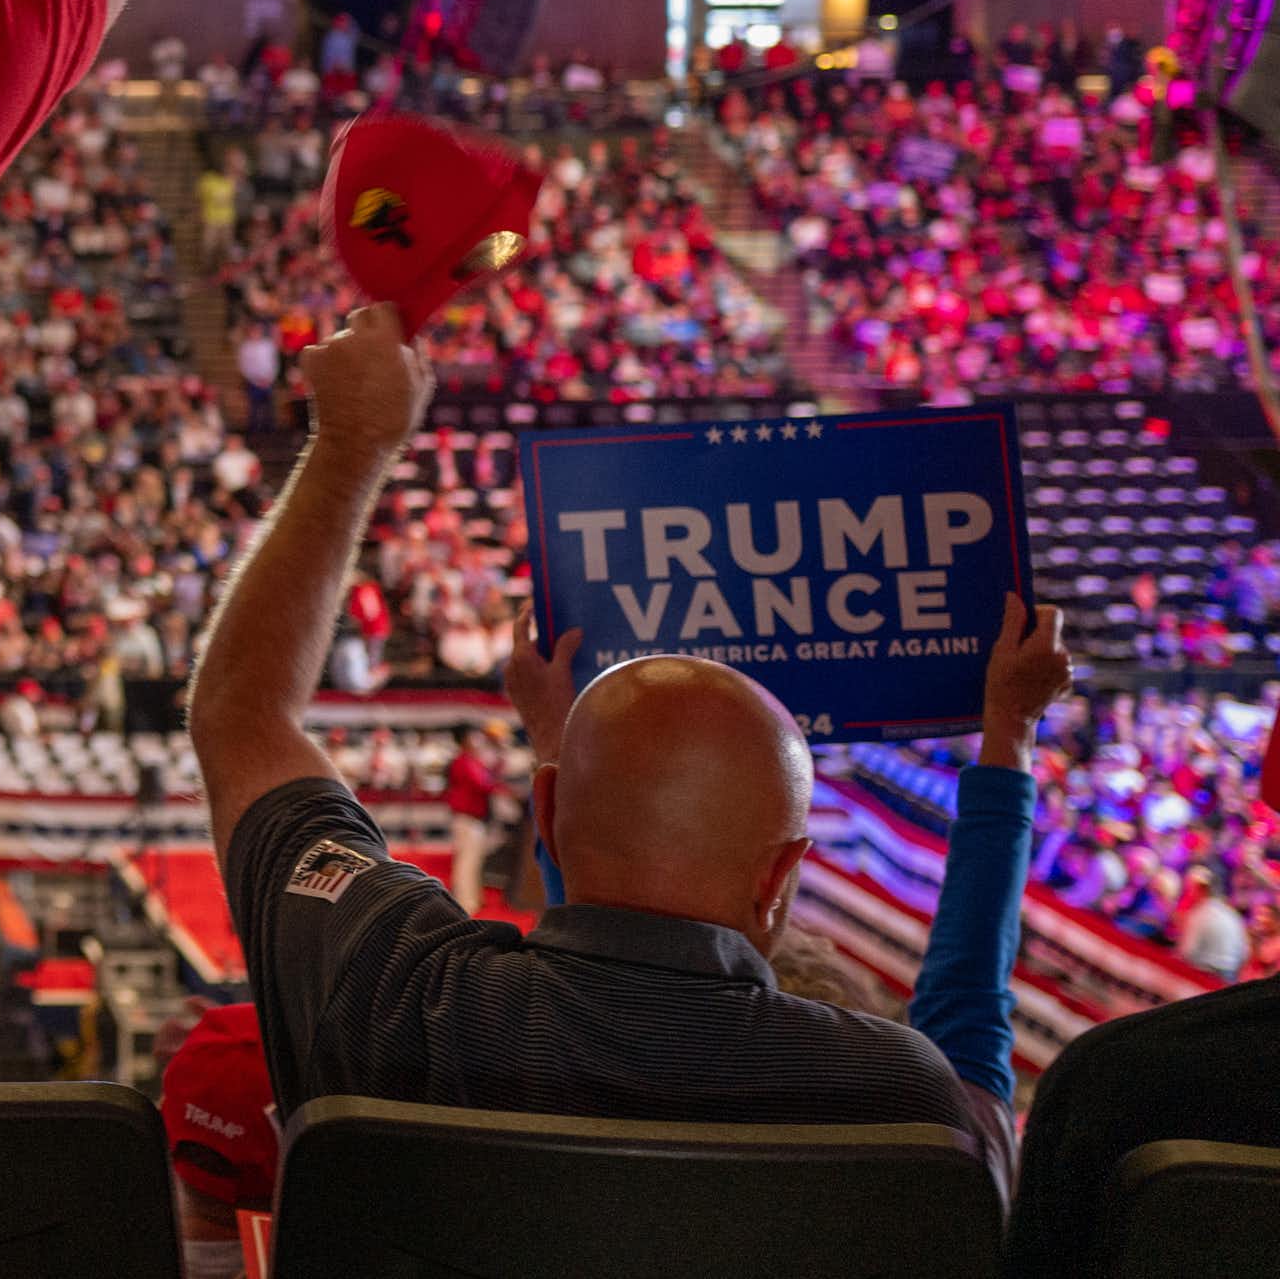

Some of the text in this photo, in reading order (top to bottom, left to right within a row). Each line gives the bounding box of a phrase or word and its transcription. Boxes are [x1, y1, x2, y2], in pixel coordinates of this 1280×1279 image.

[559, 492, 993, 582] TRUMP
[612, 570, 951, 642] VANCE
[796, 640, 878, 660] GREAT
[888, 637, 979, 657] AGAIN!
